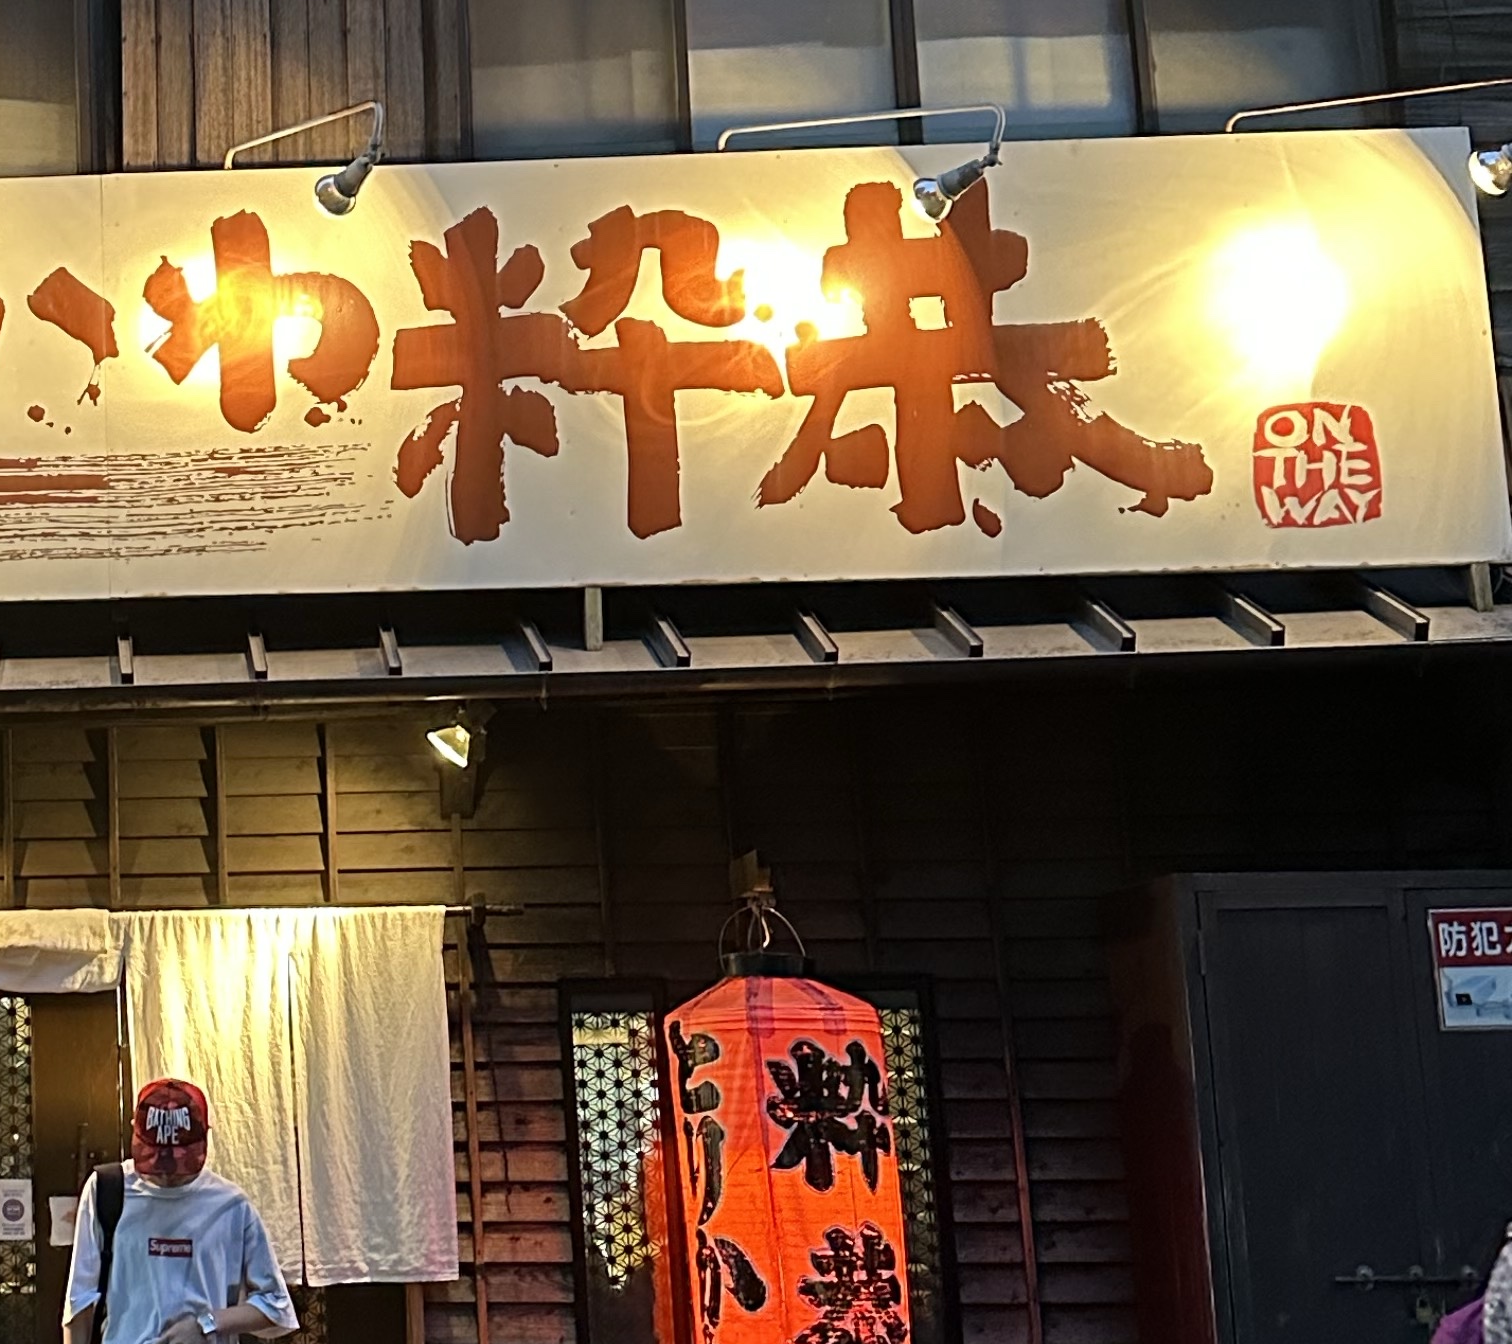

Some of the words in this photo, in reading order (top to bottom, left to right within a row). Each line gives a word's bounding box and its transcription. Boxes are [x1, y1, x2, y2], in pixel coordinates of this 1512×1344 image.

[1264, 404, 1354, 448] ON
[1253, 442, 1374, 490] THE
[1260, 487, 1381, 526] WAY
[1438, 921, 1512, 957] 防犯
[146, 1106, 191, 1131] BATHING
[156, 1125, 180, 1145] APE
[149, 1239, 192, 1255] Supreme
